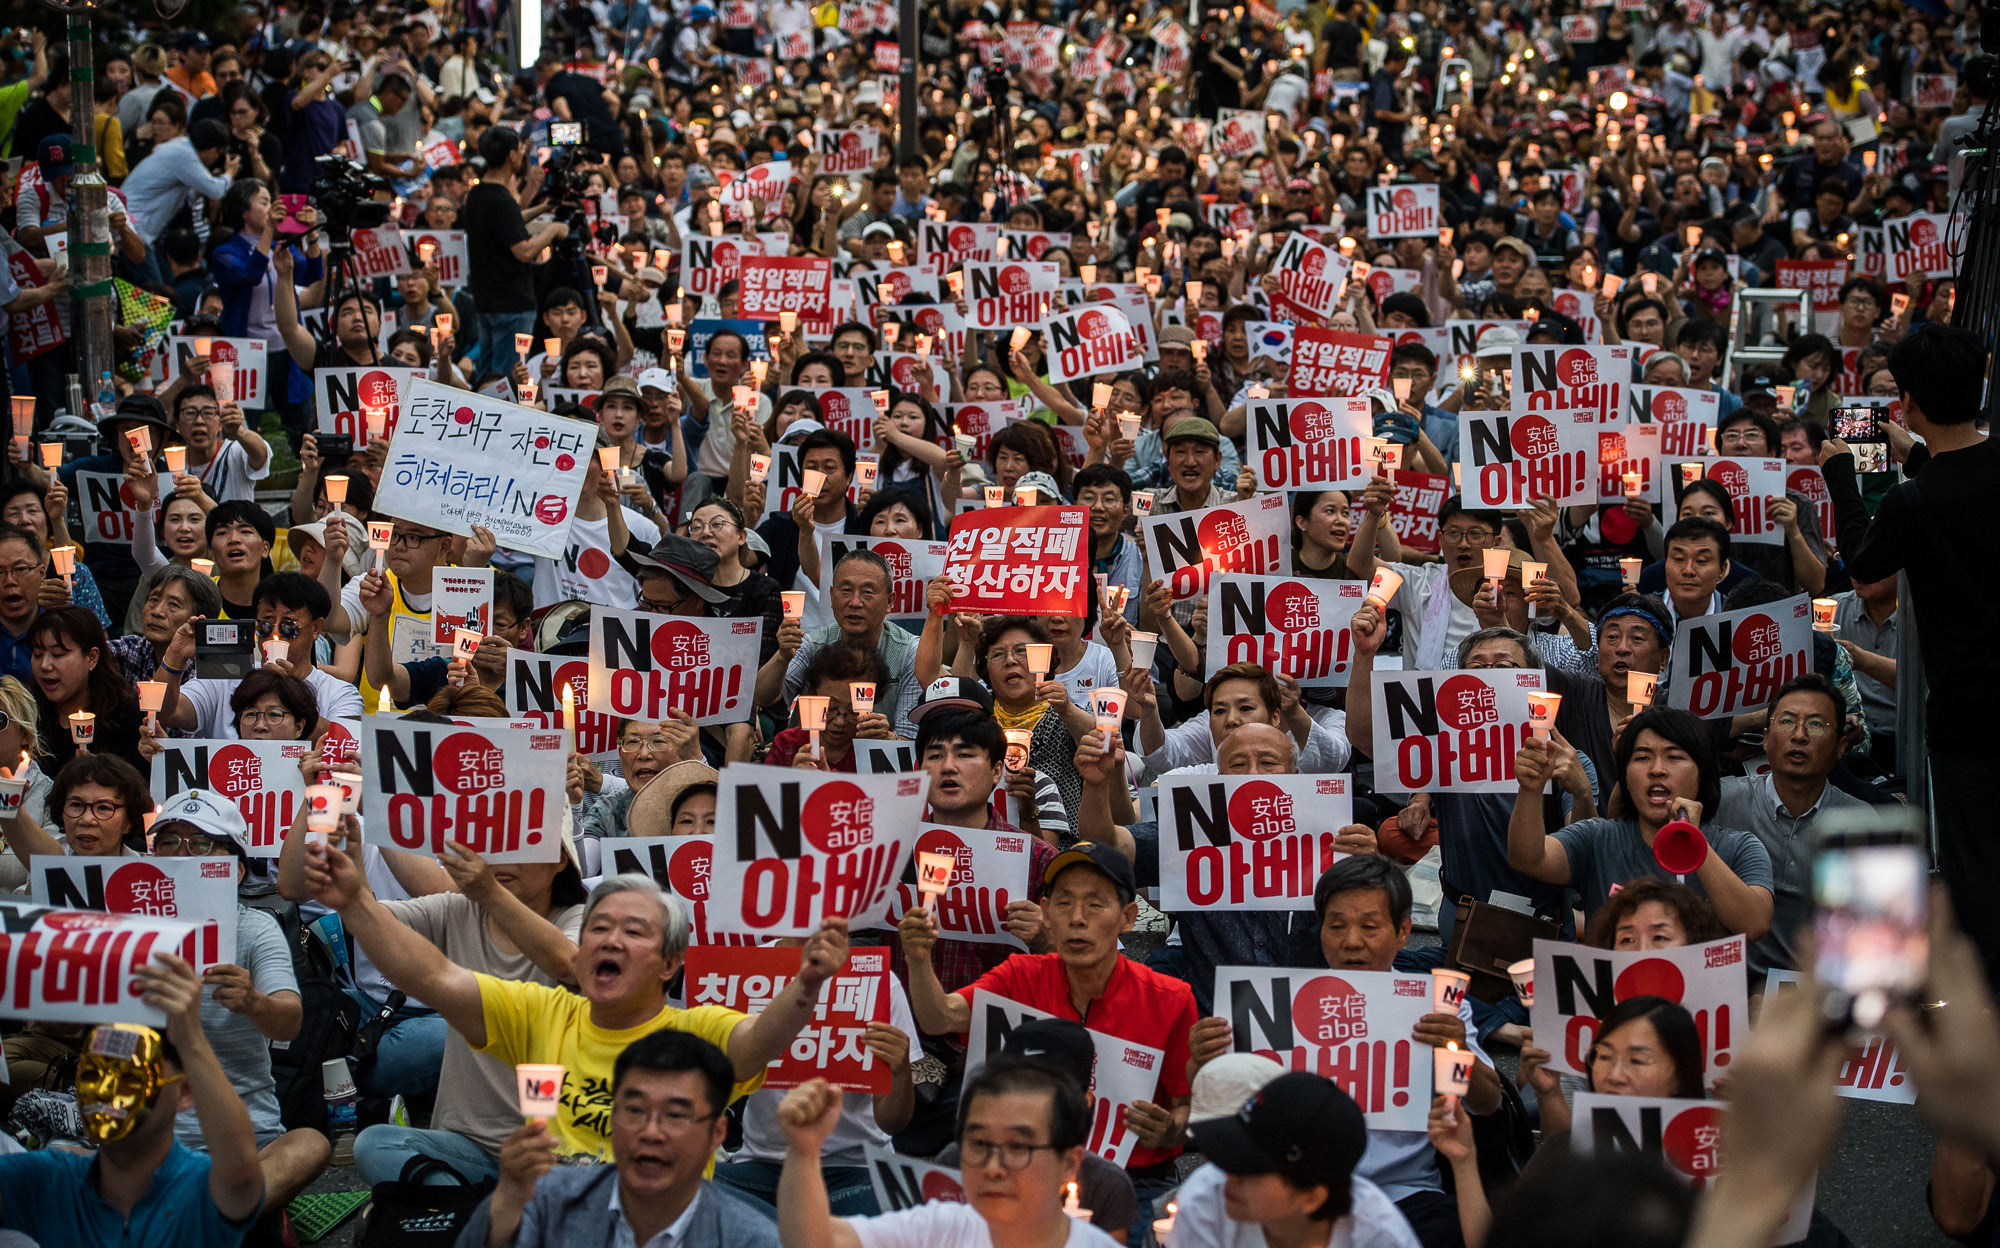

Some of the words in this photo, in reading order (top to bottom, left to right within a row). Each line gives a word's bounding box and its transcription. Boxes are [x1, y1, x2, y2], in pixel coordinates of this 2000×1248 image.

[1378, 206, 1433, 235] 아베!
[743, 267, 827, 291] 친일적폐
[1280, 268, 1333, 311] 아베!
[742, 289, 827, 313] 청산하자
[978, 291, 1050, 327] 아베!
[1061, 332, 1135, 378] 아베!
[1296, 339, 1387, 374] 친일적폐
[1571, 357, 1598, 372] 安倍
[1571, 370, 1598, 385] abe
[372, 394, 398, 404] abe
[1304, 411, 1333, 427] 安倍
[1305, 425, 1335, 439] abe
[1527, 425, 1557, 441] 安倍
[1527, 439, 1559, 455] abe
[1263, 436, 1362, 488] 아베!
[395, 455, 515, 513] 해체하라!
[1480, 450, 1586, 506] 아베!
[1214, 514, 1247, 536] 安倍
[950, 527, 1081, 561] 친일적폐
[1217, 530, 1250, 552] abe
[946, 564, 1080, 599] 청산하자
[1285, 594, 1319, 614] 安倍
[1284, 612, 1320, 628] abe
[672, 634, 710, 652] 安倍
[1750, 621, 1780, 644] 安倍
[671, 652, 711, 667] abe
[1227, 628, 1351, 679] 아베!
[1749, 640, 1782, 662] abe
[611, 664, 742, 719] 아베!
[1457, 686, 1495, 709] 安倍
[1458, 706, 1498, 724] abe
[228, 756, 262, 776] 安倍
[459, 747, 504, 771] 安倍
[226, 774, 263, 791] abe
[457, 769, 505, 789] abe
[1252, 794, 1293, 817] 安倍
[388, 787, 545, 854] 아베!
[1252, 817, 1296, 835] abe
[827, 824, 873, 848] abe
[1186, 832, 1335, 906] 아베!
[130, 877, 176, 903] 安倍
[741, 840, 900, 929] 아베!
[694, 973, 881, 1021] 친일폐
[1319, 994, 1366, 1019] 安倍
[1319, 1018, 1368, 1040] abe
